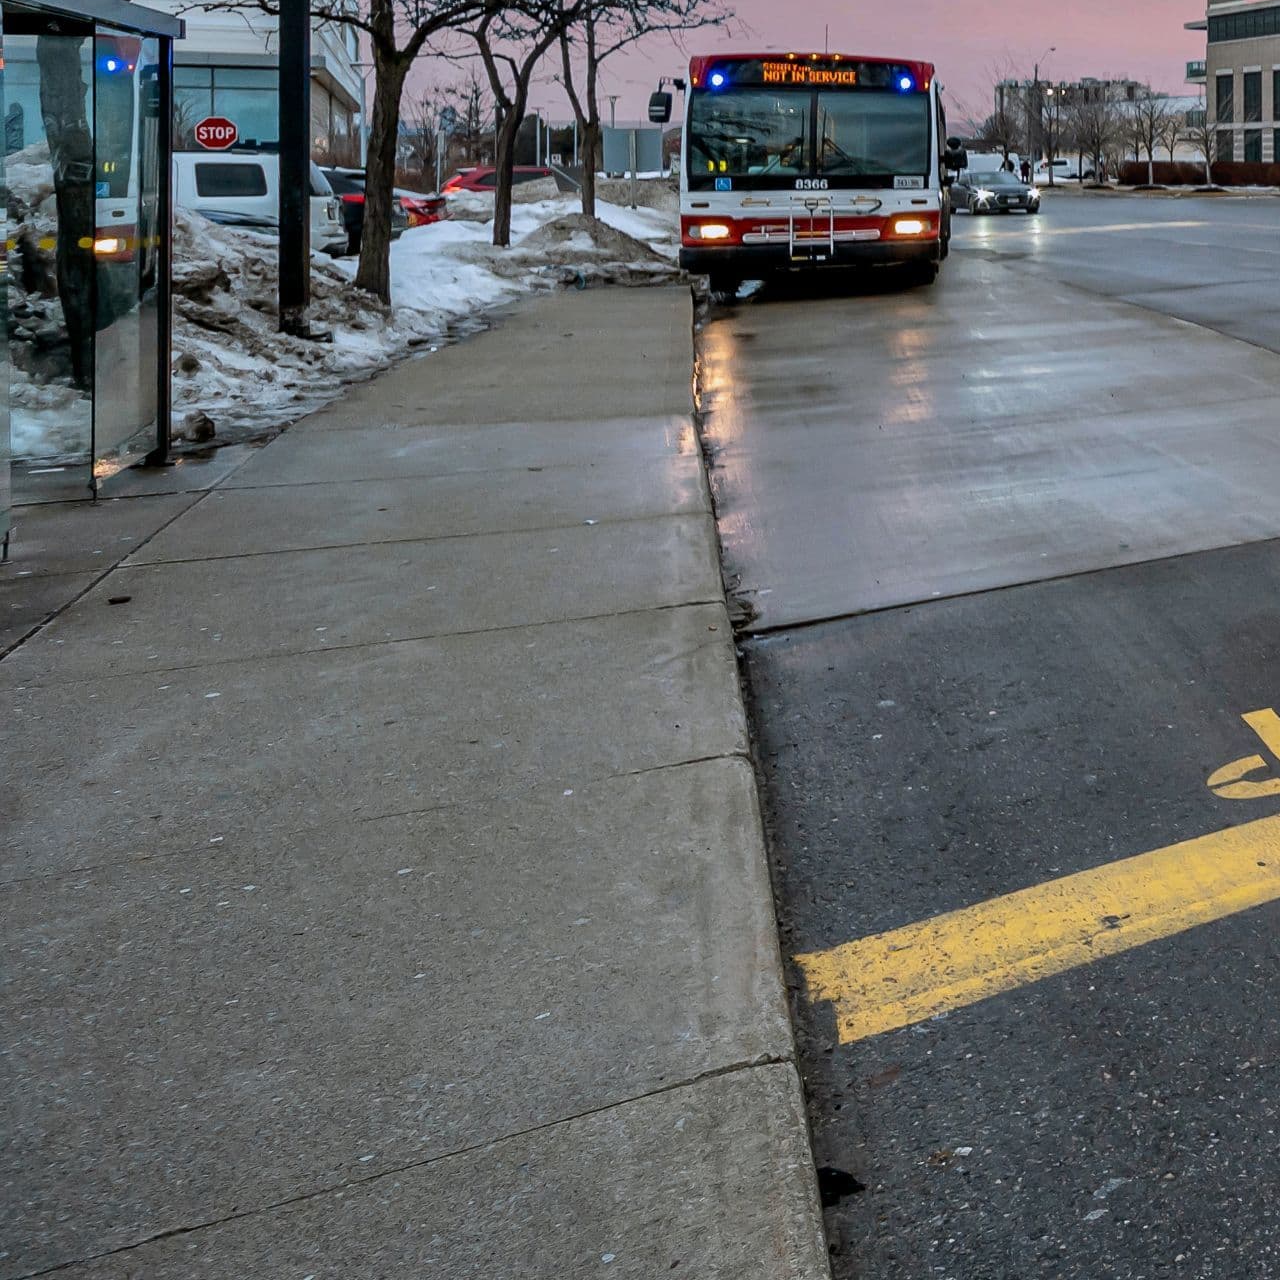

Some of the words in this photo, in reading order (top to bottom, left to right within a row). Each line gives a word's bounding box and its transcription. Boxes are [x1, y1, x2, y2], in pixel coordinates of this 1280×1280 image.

[764, 71, 786, 82] NOT
[792, 71, 805, 82] IN
[809, 71, 856, 83] SERVICE
[199, 126, 235, 140] STOP
[795, 178, 829, 190] 8366
